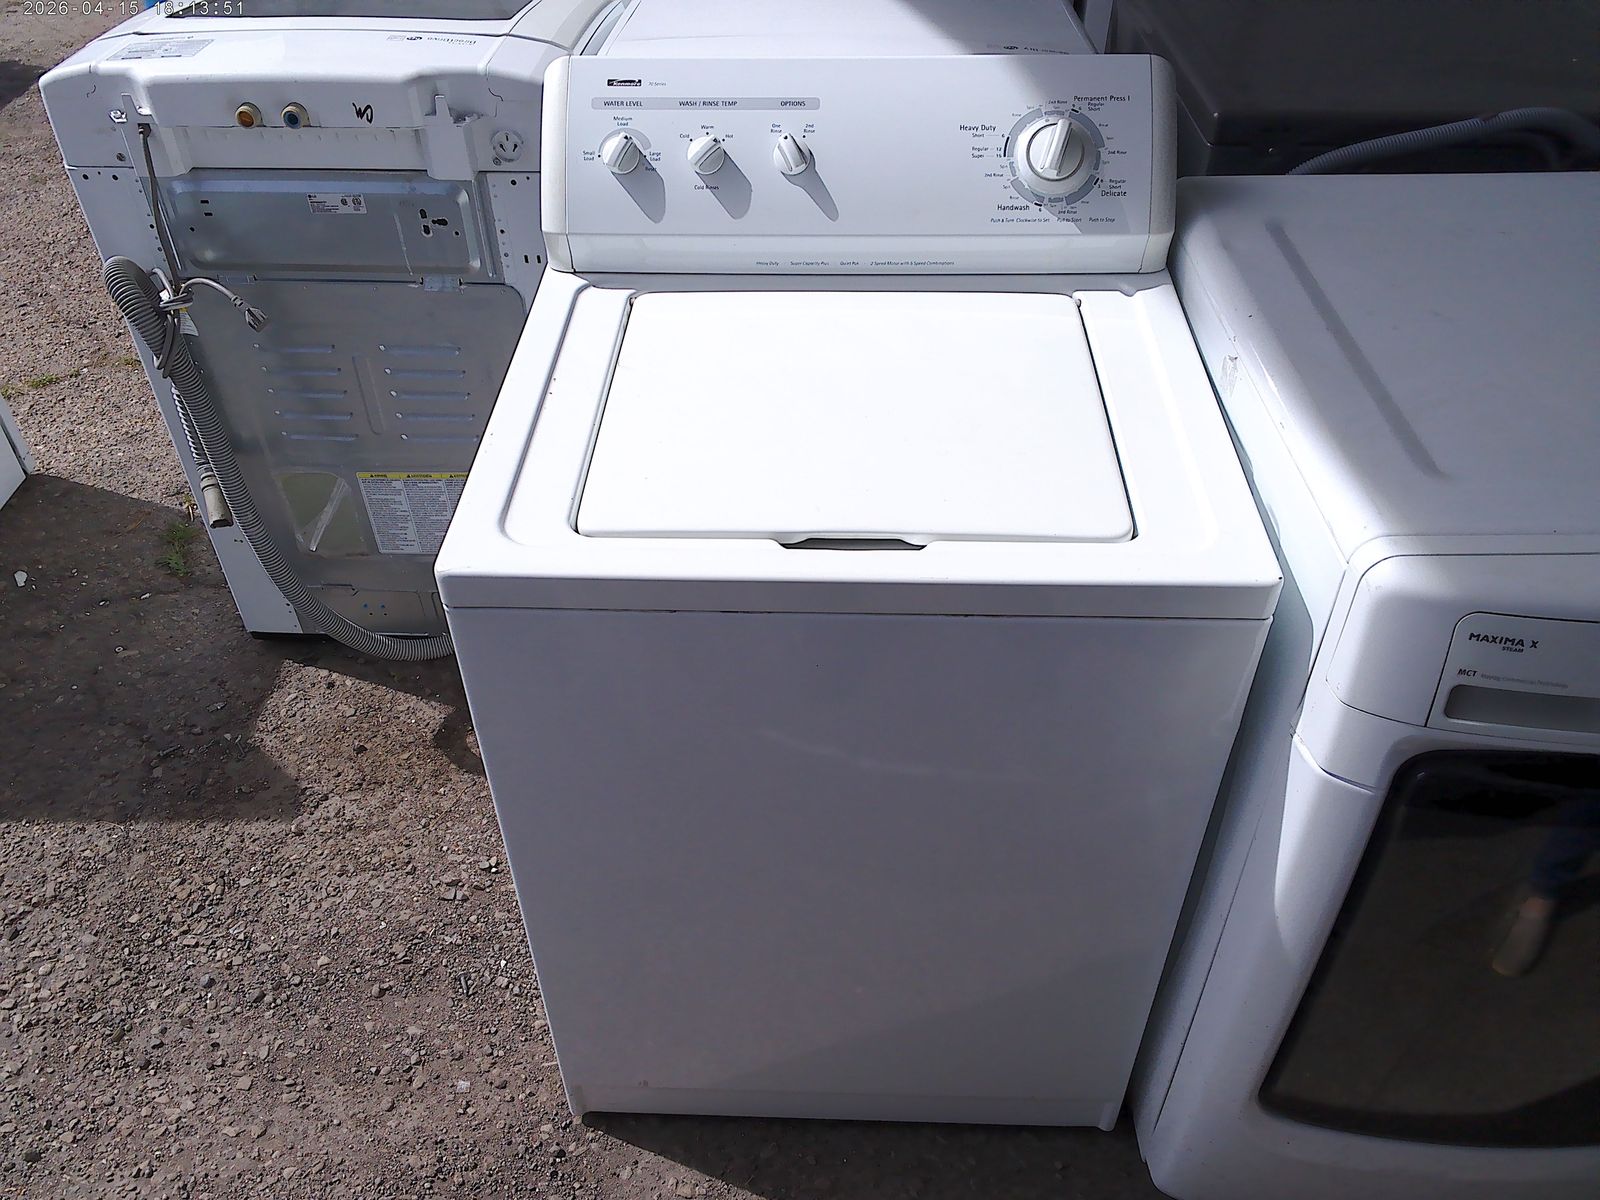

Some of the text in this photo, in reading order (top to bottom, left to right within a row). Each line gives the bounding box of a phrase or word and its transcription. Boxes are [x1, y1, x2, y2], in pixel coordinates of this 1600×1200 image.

[959, 124, 996, 132] Heavy Duty
[1101, 189, 1127, 197] Delicate
[1468, 632, 1540, 649] MAXIMA X
[1501, 645, 1524, 653] STEAM
[1457, 668, 1478, 677] MCT
